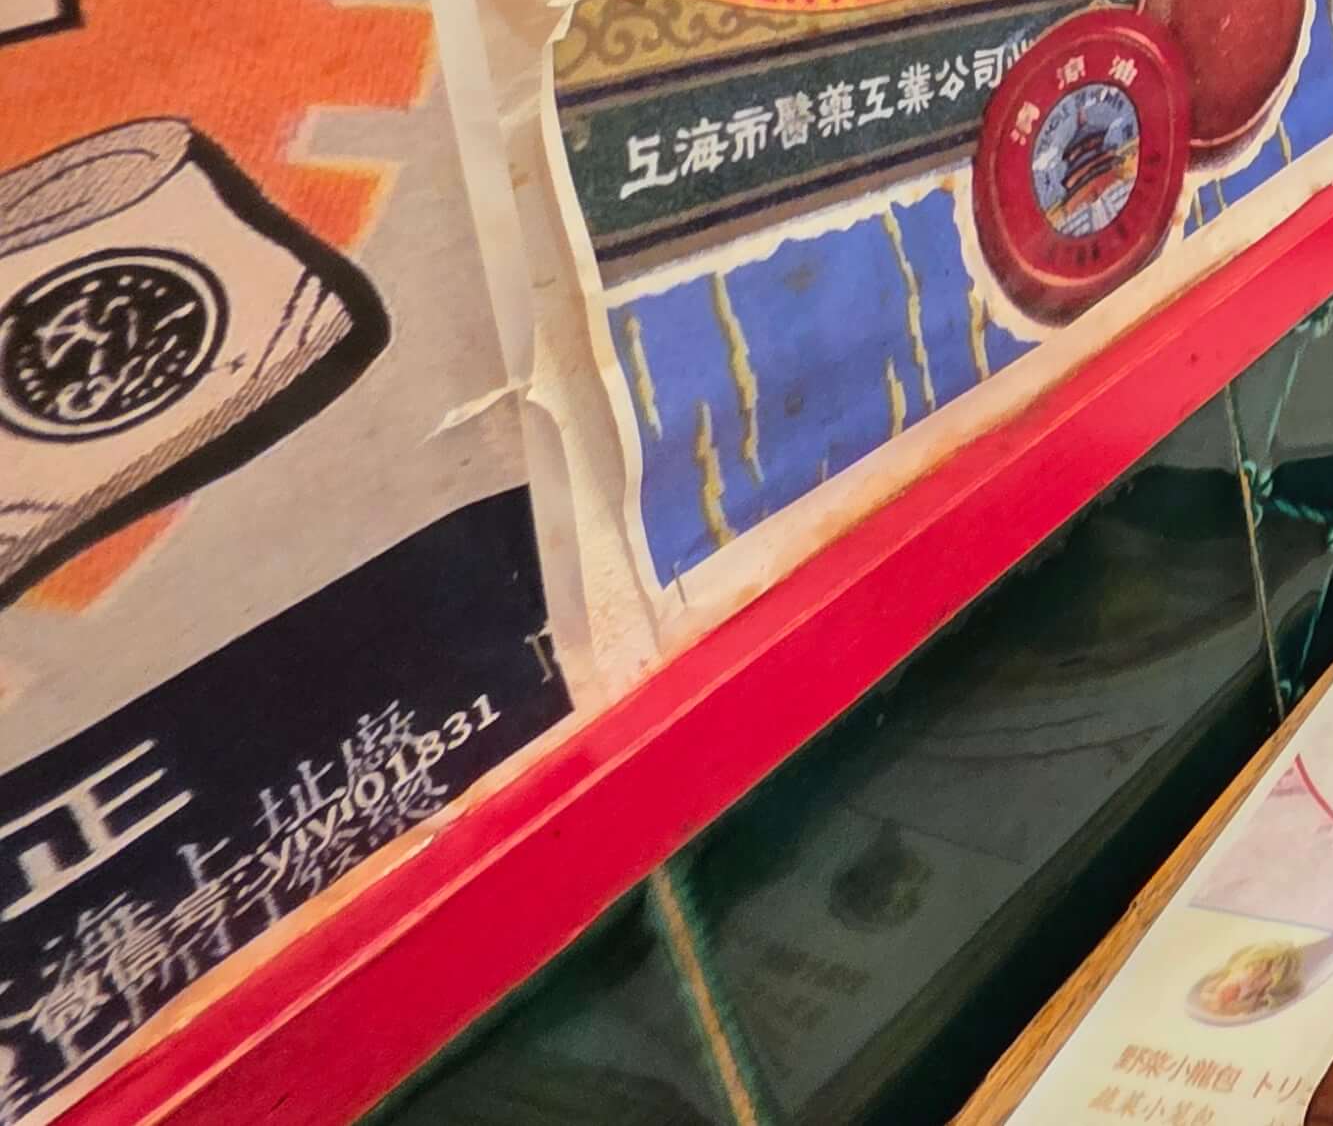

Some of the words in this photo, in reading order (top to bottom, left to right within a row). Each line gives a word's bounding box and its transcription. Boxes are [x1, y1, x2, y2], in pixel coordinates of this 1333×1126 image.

[620, 26, 1034, 201] 上海市醫藥工業公司
